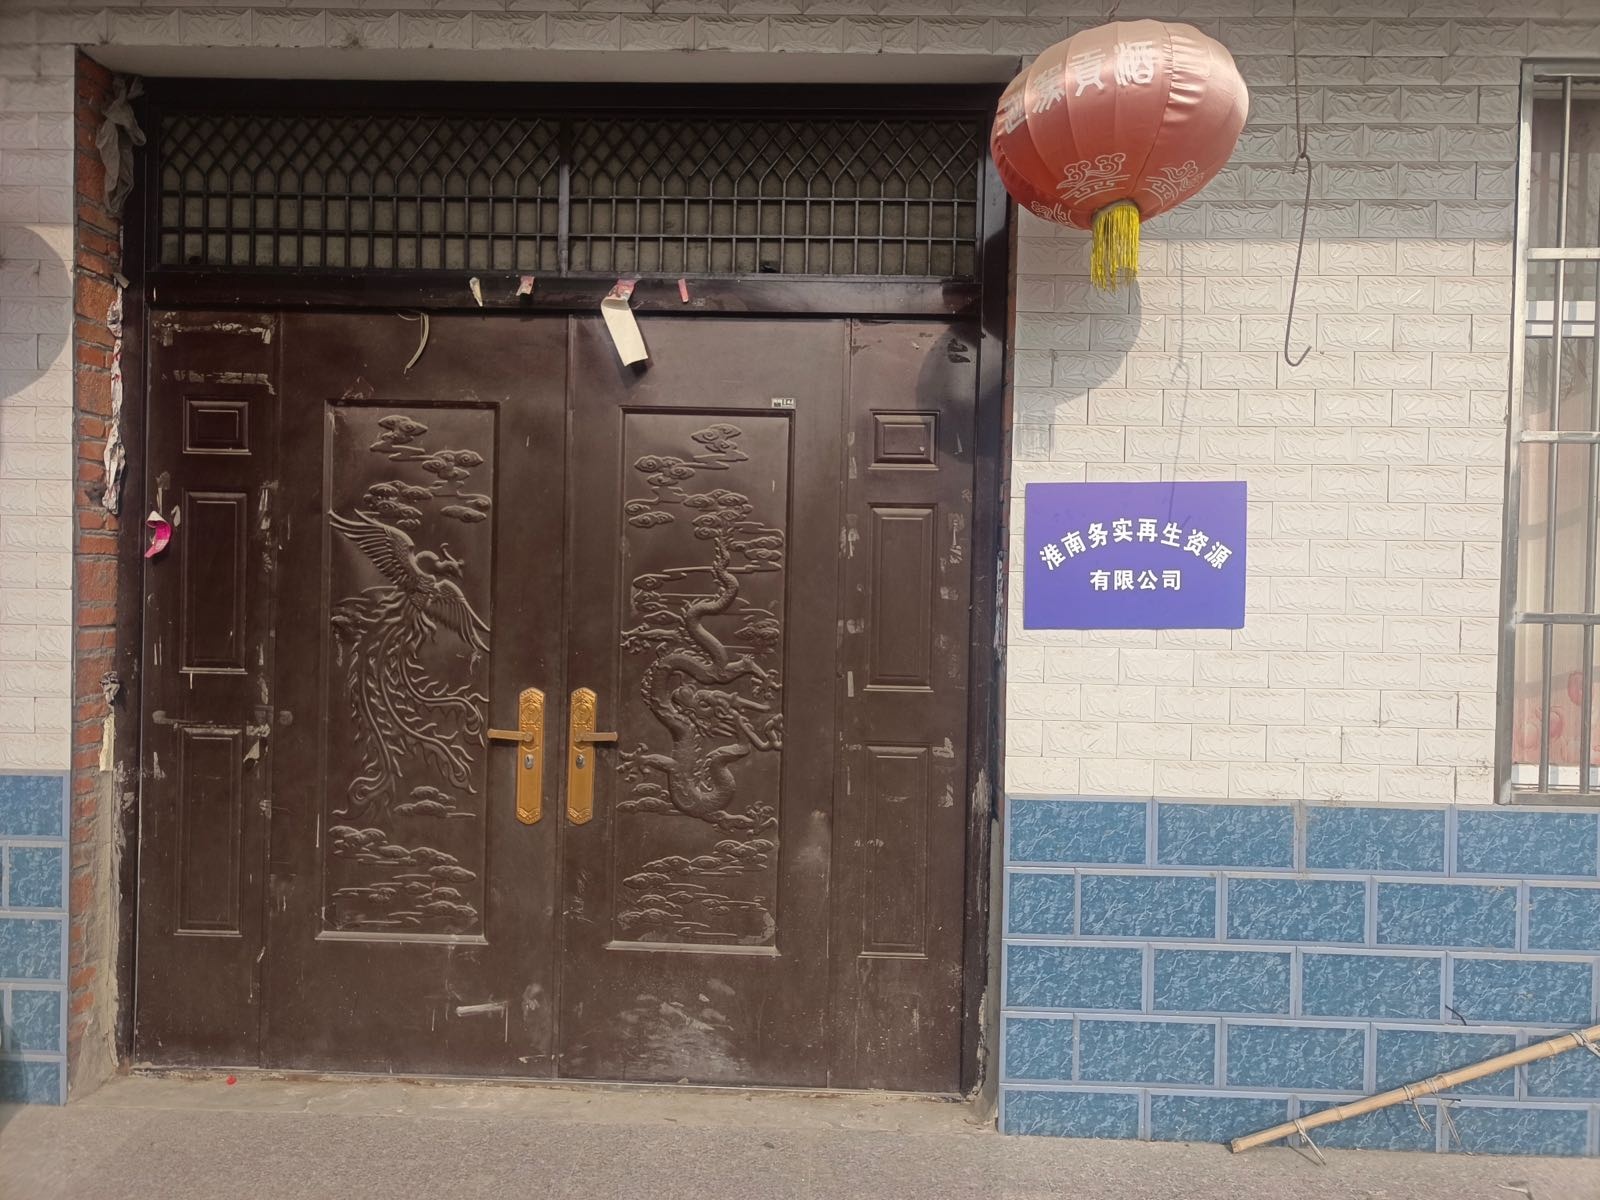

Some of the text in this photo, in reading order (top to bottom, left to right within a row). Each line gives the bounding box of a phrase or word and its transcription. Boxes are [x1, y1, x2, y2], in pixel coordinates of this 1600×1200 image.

[1039, 517, 1233, 571] 淮南务实再生资源
[1089, 570, 1182, 591] 有限公司
